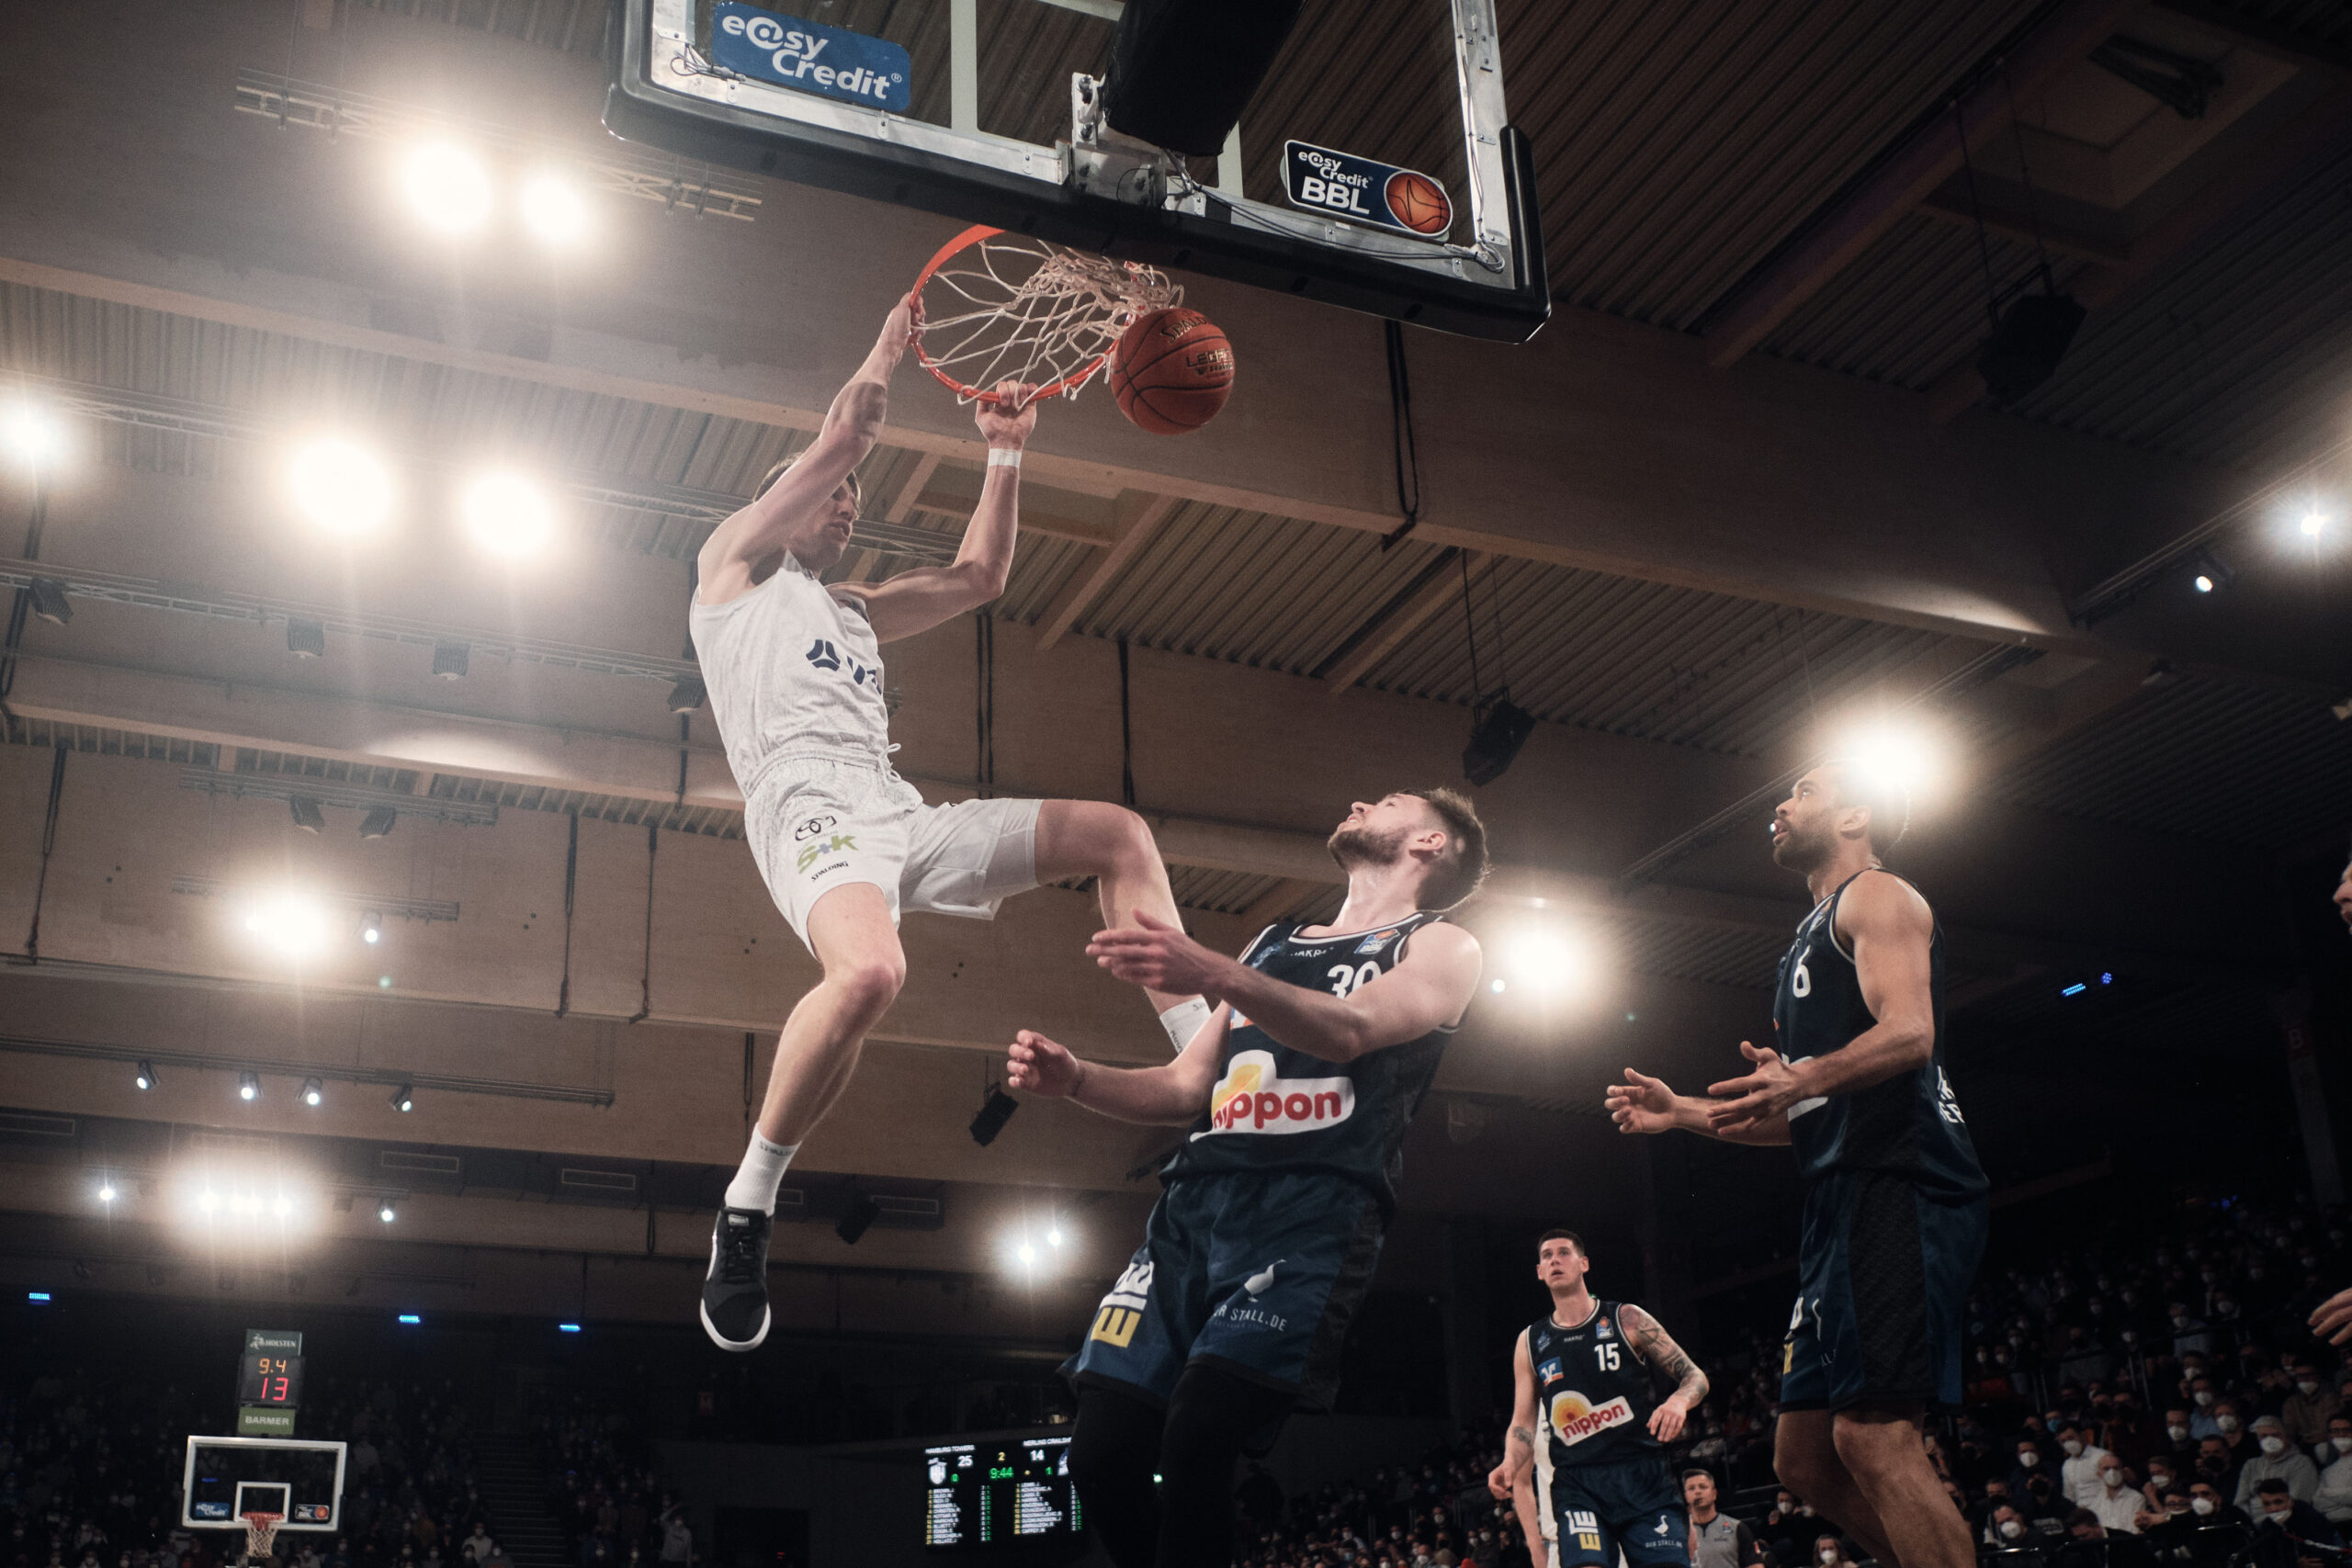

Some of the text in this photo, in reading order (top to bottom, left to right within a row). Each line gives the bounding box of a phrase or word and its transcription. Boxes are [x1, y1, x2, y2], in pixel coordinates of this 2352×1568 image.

[1301, 176, 1370, 214] BBL
[810, 861, 850, 882] SPALDING
[1792, 944, 1811, 998] 6
[1213, 1091, 1342, 1130] nippon
[1230, 1308, 1287, 1332] STALL.DE
[258, 1358, 287, 1374] 9.4
[1594, 1342, 1621, 1371] 15
[261, 1378, 288, 1401] 13
[244, 1416, 289, 1426] BARMER
[1563, 1404, 1625, 1439] nippon
[958, 1455, 973, 1467] 25
[999, 1451, 1005, 1461] 2
[1030, 1450, 1044, 1461] 14
[989, 1467, 1013, 1478] 9:44
